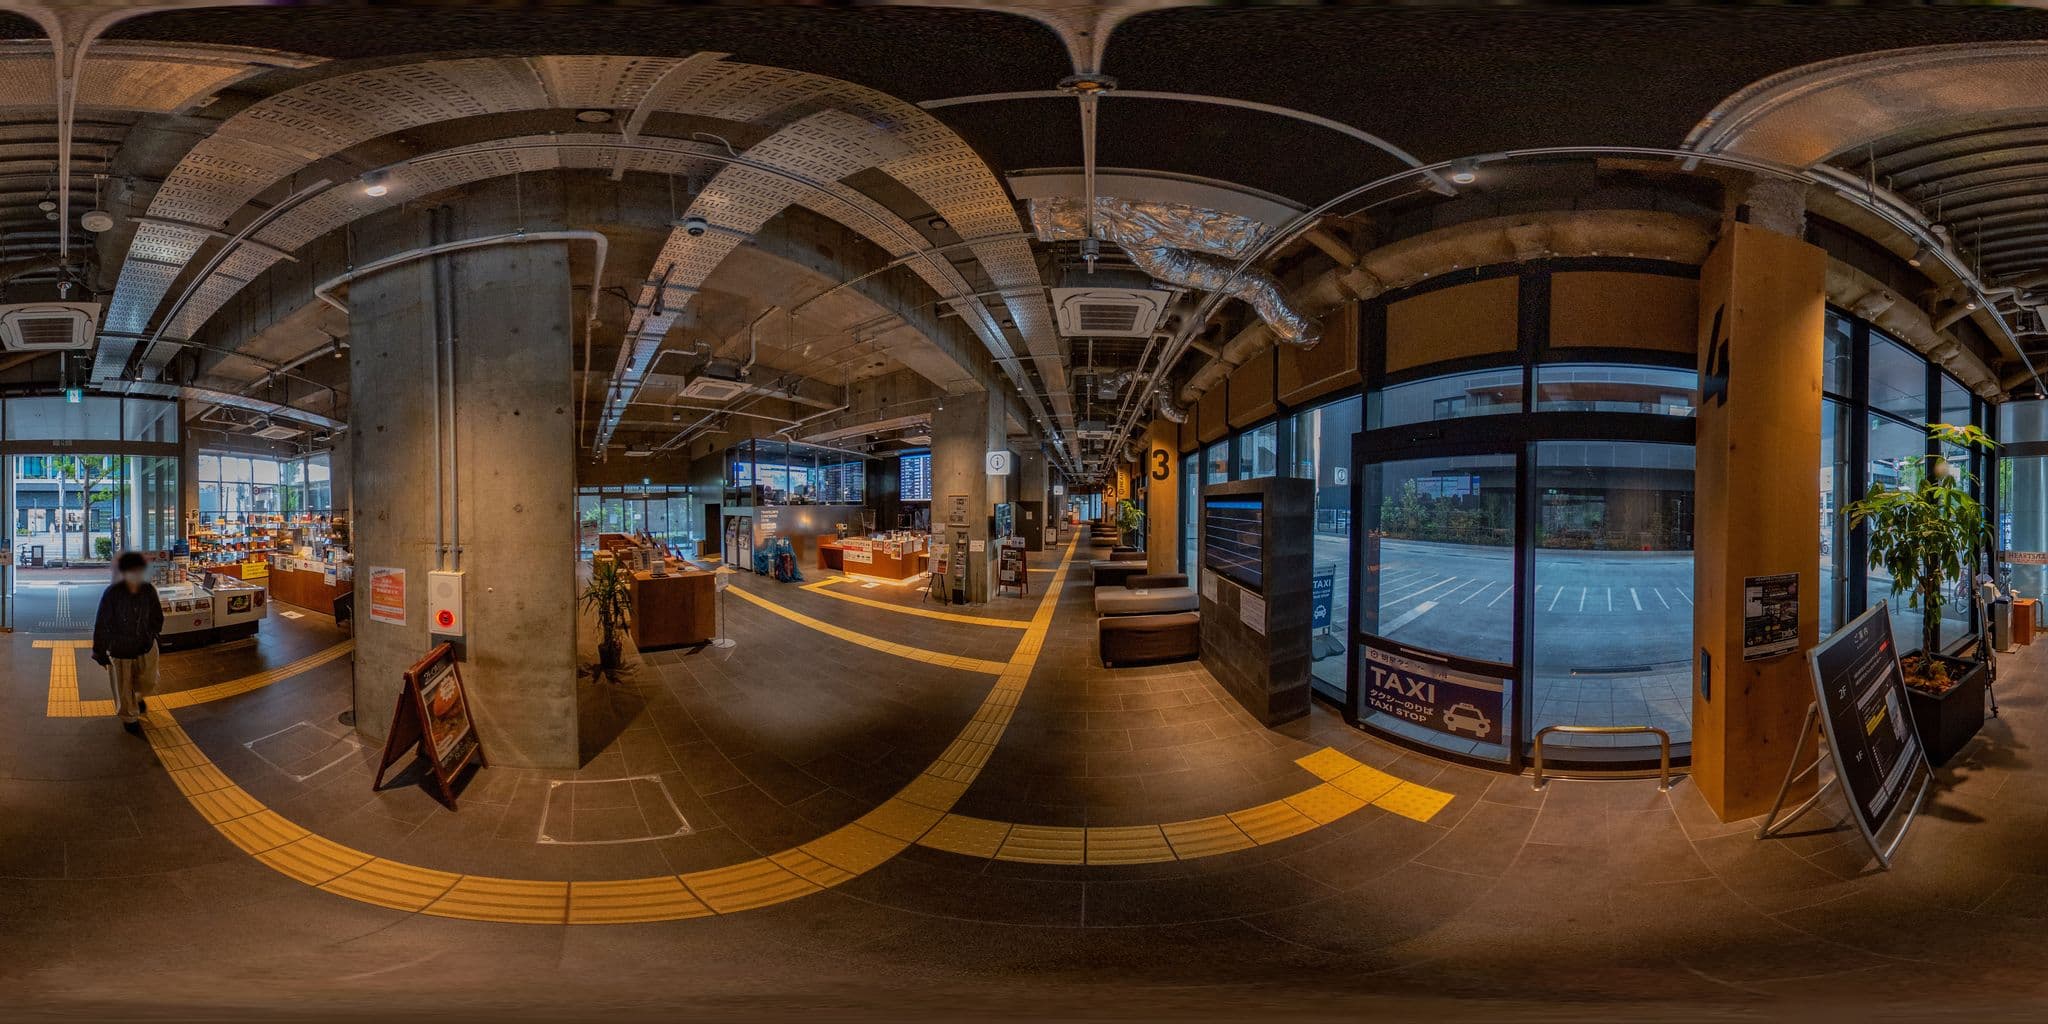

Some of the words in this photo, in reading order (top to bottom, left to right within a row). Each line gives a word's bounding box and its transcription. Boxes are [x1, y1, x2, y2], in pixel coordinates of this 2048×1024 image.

[1703, 303, 1729, 408] 4
[1152, 449, 1169, 480] 3
[1107, 486, 1113, 497] 2
[1313, 579, 1331, 588] TAXI
[1370, 666, 1434, 703] TAXI
[1838, 685, 1847, 700] 2F
[1370, 689, 1434, 715] タクシーのりば
[1370, 697, 1392, 711] TAXI
[1396, 707, 1427, 722] STOP
[1856, 750, 1863, 762] 1F
